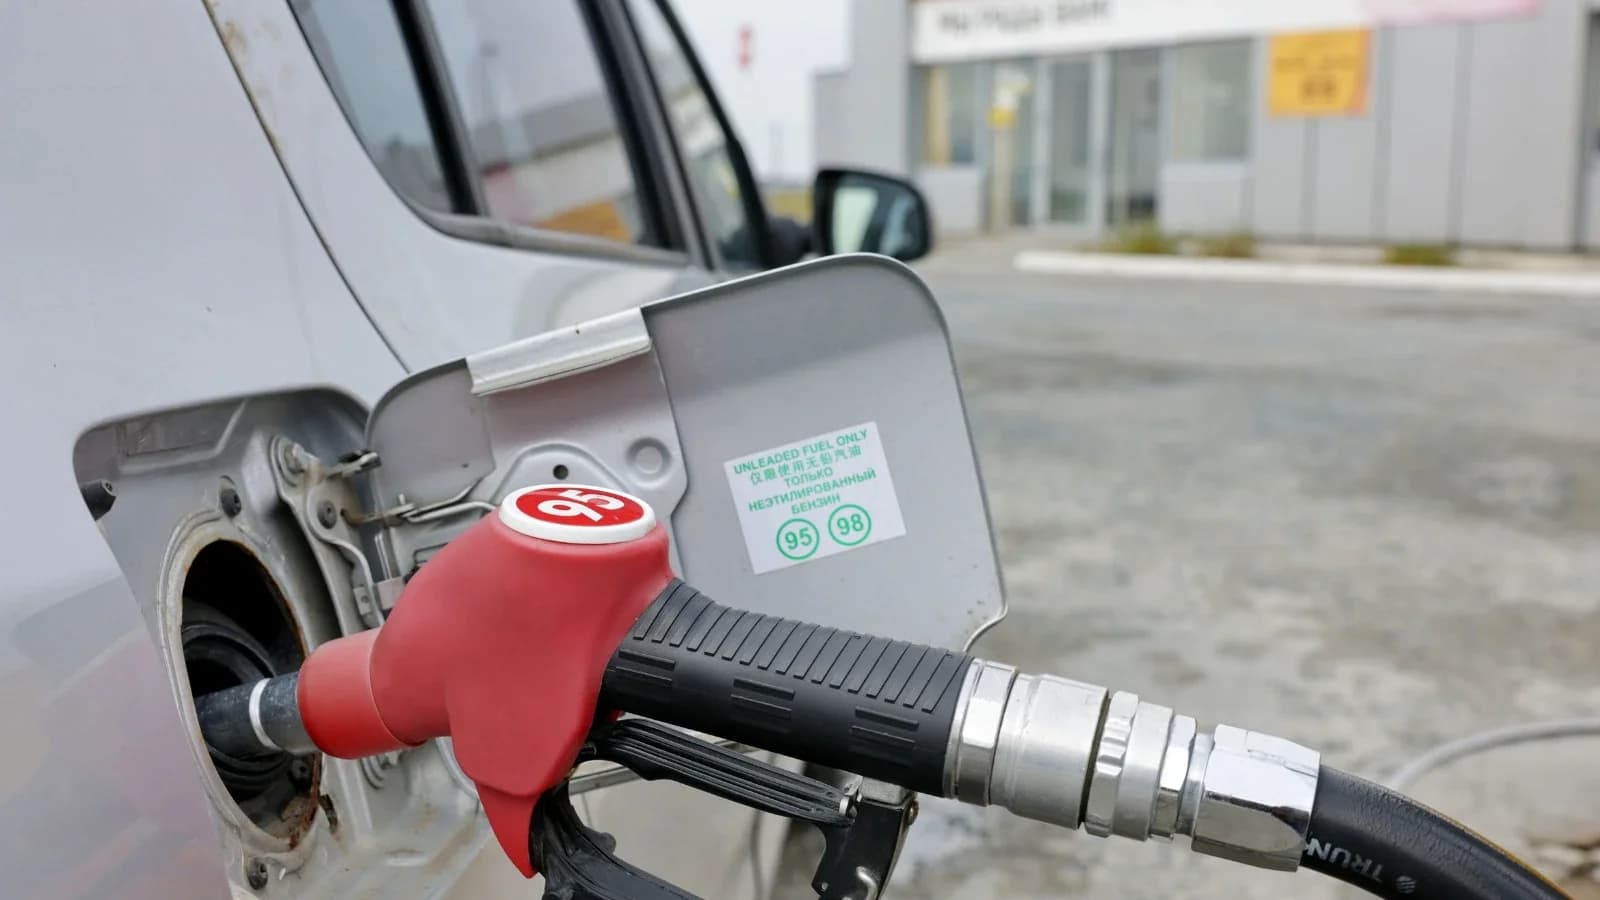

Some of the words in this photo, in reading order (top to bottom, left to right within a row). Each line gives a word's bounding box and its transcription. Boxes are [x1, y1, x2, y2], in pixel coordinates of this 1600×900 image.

[734, 448, 800, 474] UNLEADED
[802, 440, 833, 456] FUEL
[836, 429, 868, 447] ONLY
[748, 467, 877, 512] НЕЭТИЛИРОВАННЫЙ
[784, 466, 834, 488] ТОЛЬКО
[537, 489, 625, 522] 95
[791, 493, 841, 514] БЕНЗИН
[784, 527, 812, 550] 95
[837, 513, 864, 536] 98
